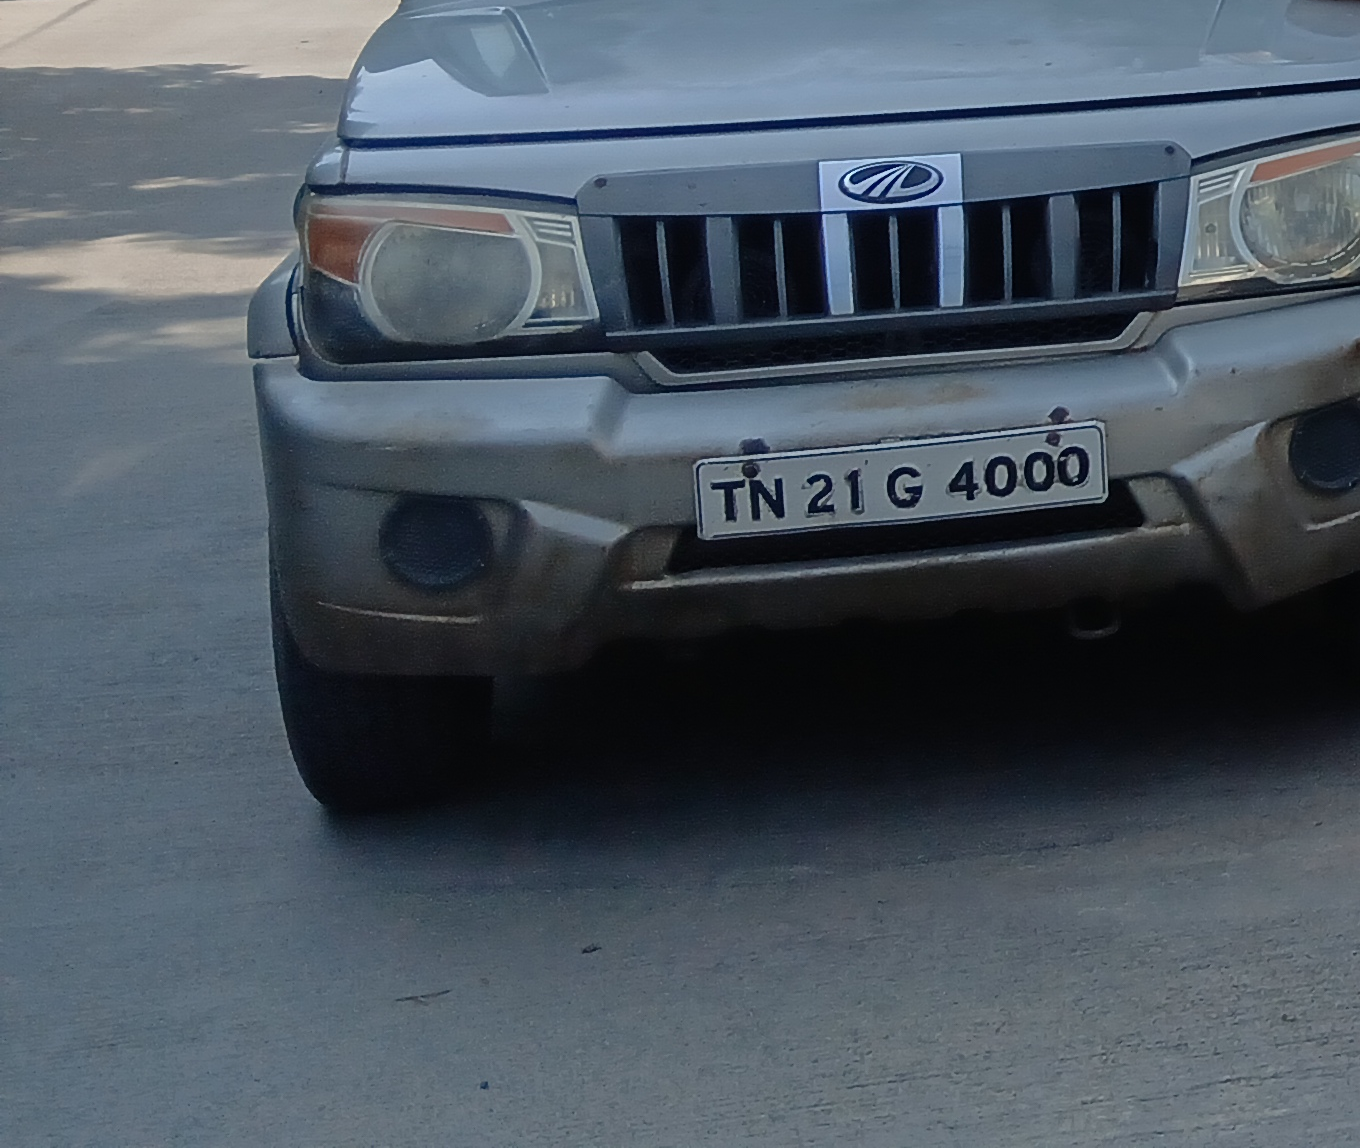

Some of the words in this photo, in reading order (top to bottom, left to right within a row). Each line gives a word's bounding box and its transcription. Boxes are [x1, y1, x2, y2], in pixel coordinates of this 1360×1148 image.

[710, 477, 786, 523] TN
[802, 467, 865, 518] 21
[885, 465, 924, 509] G
[948, 445, 1091, 501] 4000
